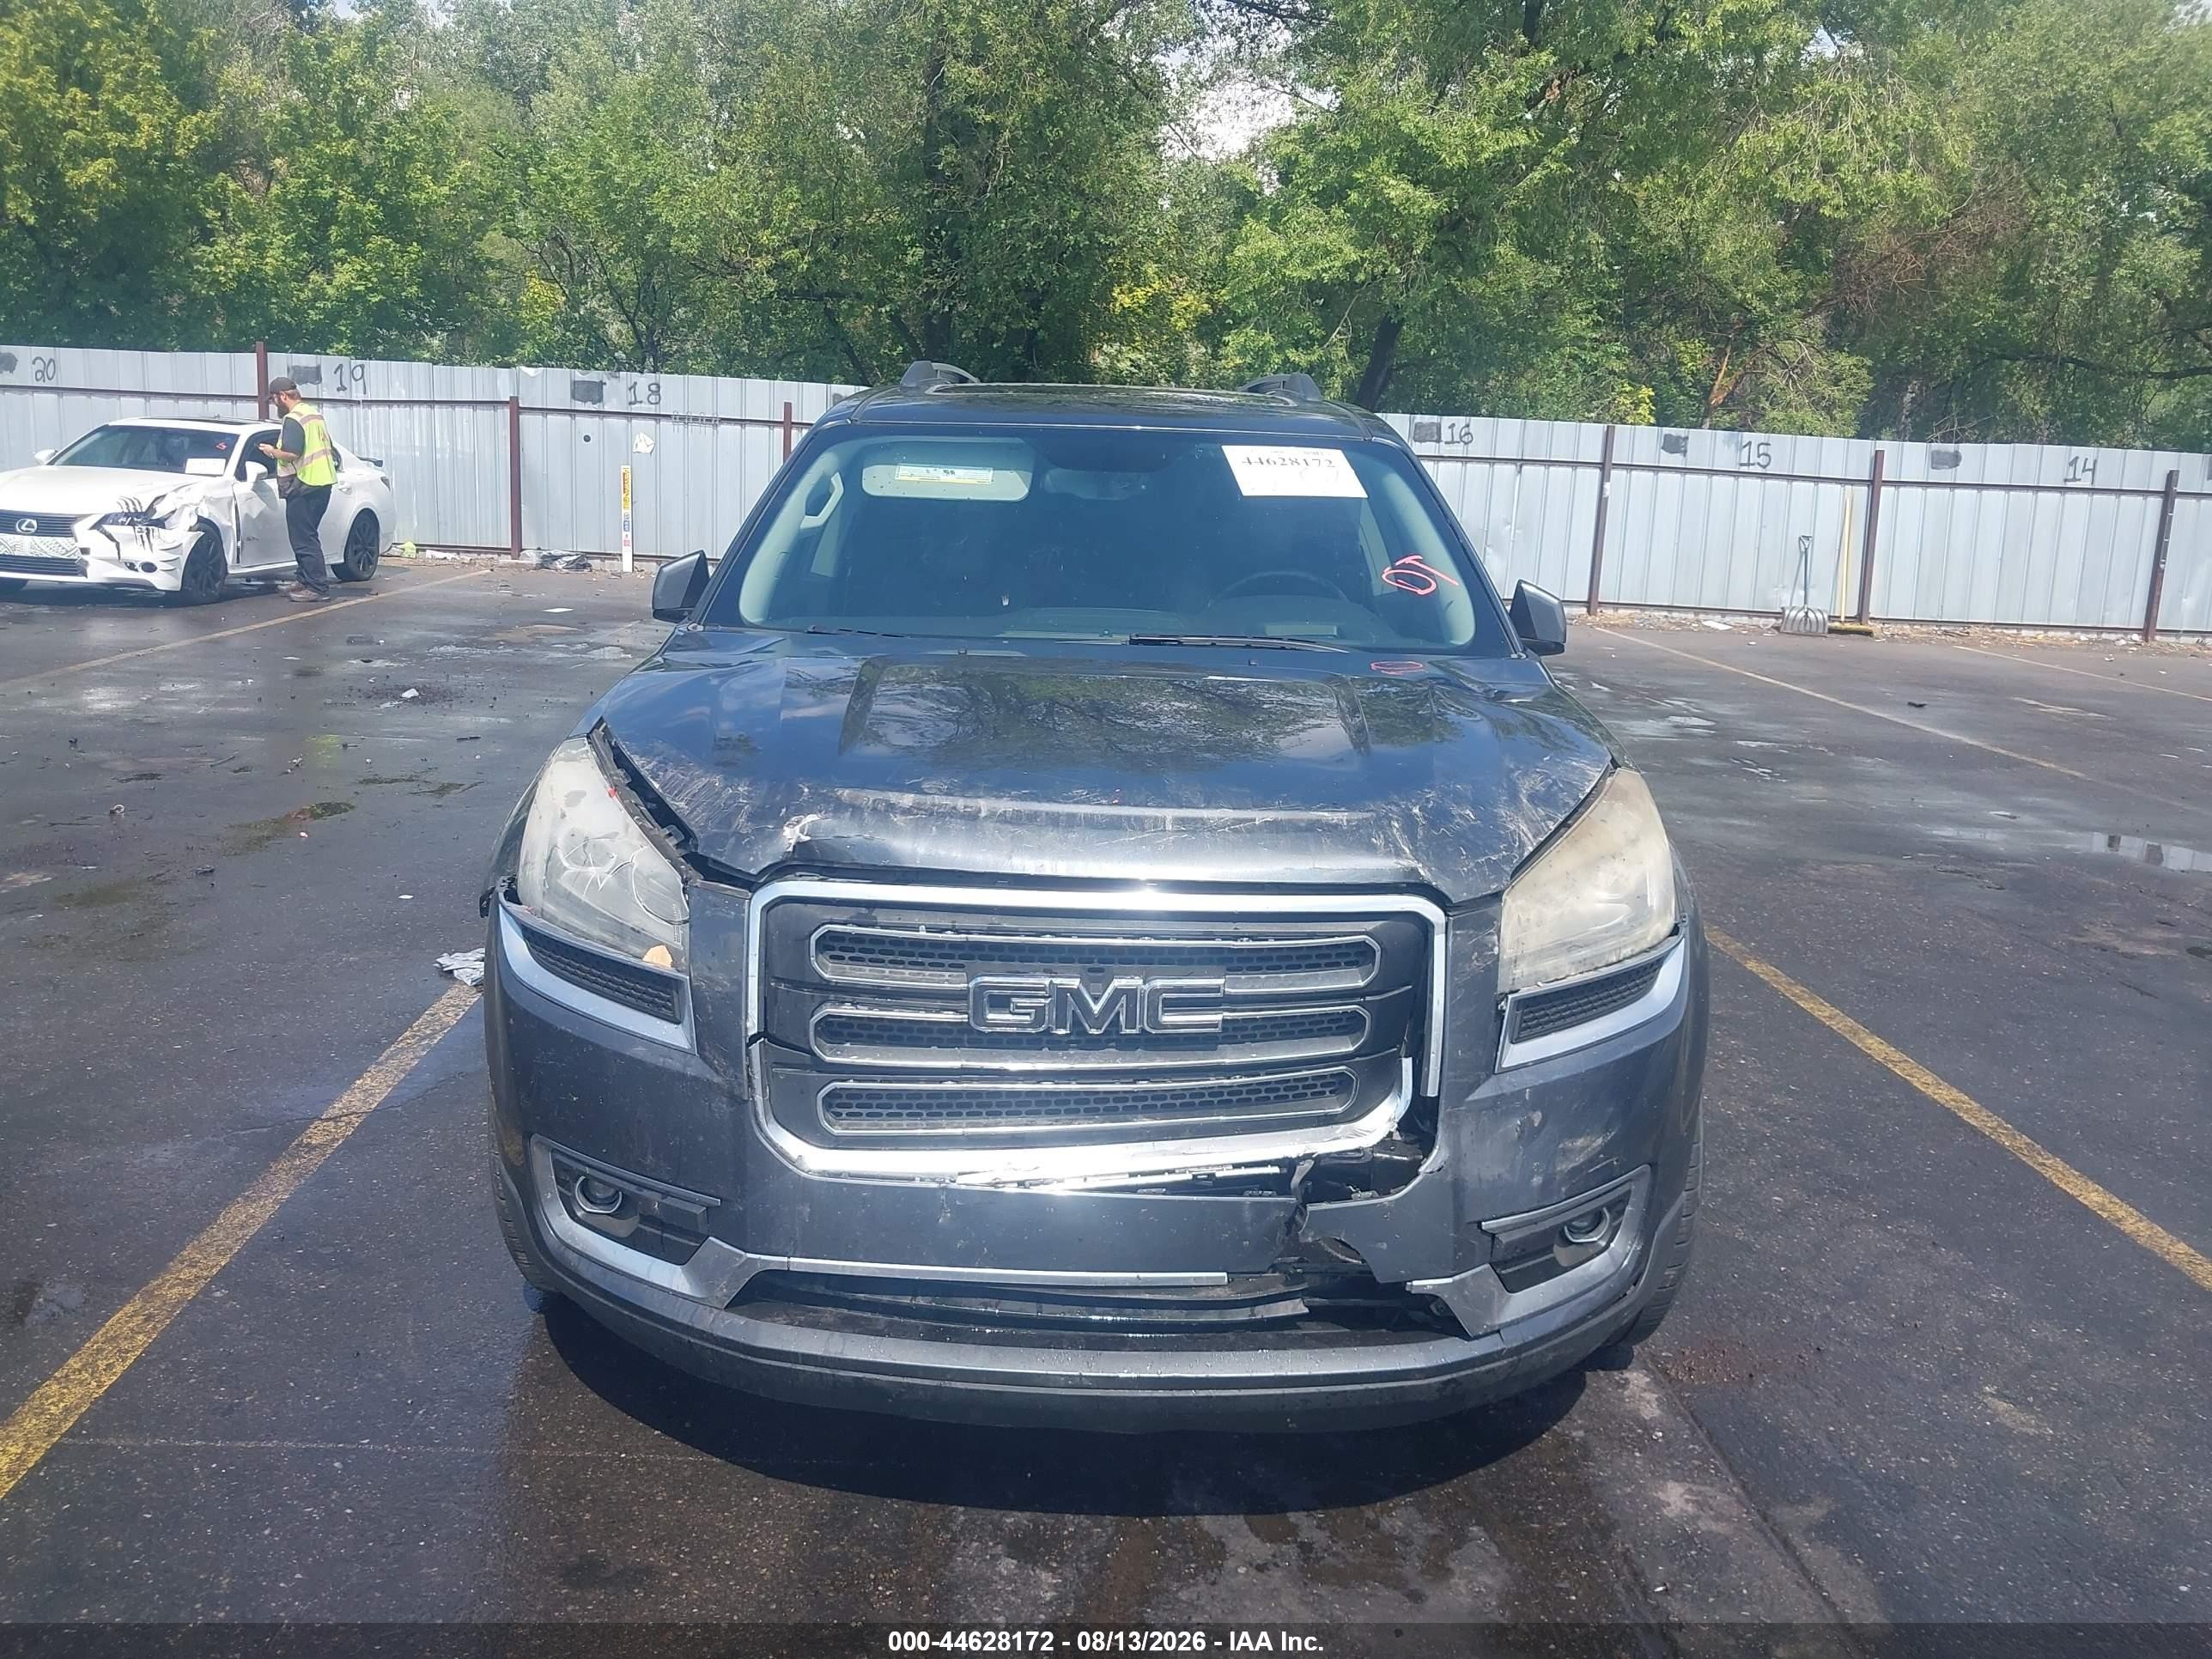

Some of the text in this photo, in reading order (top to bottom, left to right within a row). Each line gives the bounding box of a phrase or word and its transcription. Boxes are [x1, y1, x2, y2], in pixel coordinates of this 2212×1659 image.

[32, 356, 56, 383] 20
[333, 363, 367, 395] 19
[628, 381, 661, 405] 18
[1444, 422, 1474, 445] 16
[1242, 456, 1336, 468] 44628172
[1739, 441, 1771, 469] 15
[2063, 456, 2097, 486] 14
[969, 973, 1226, 1034] GMC
